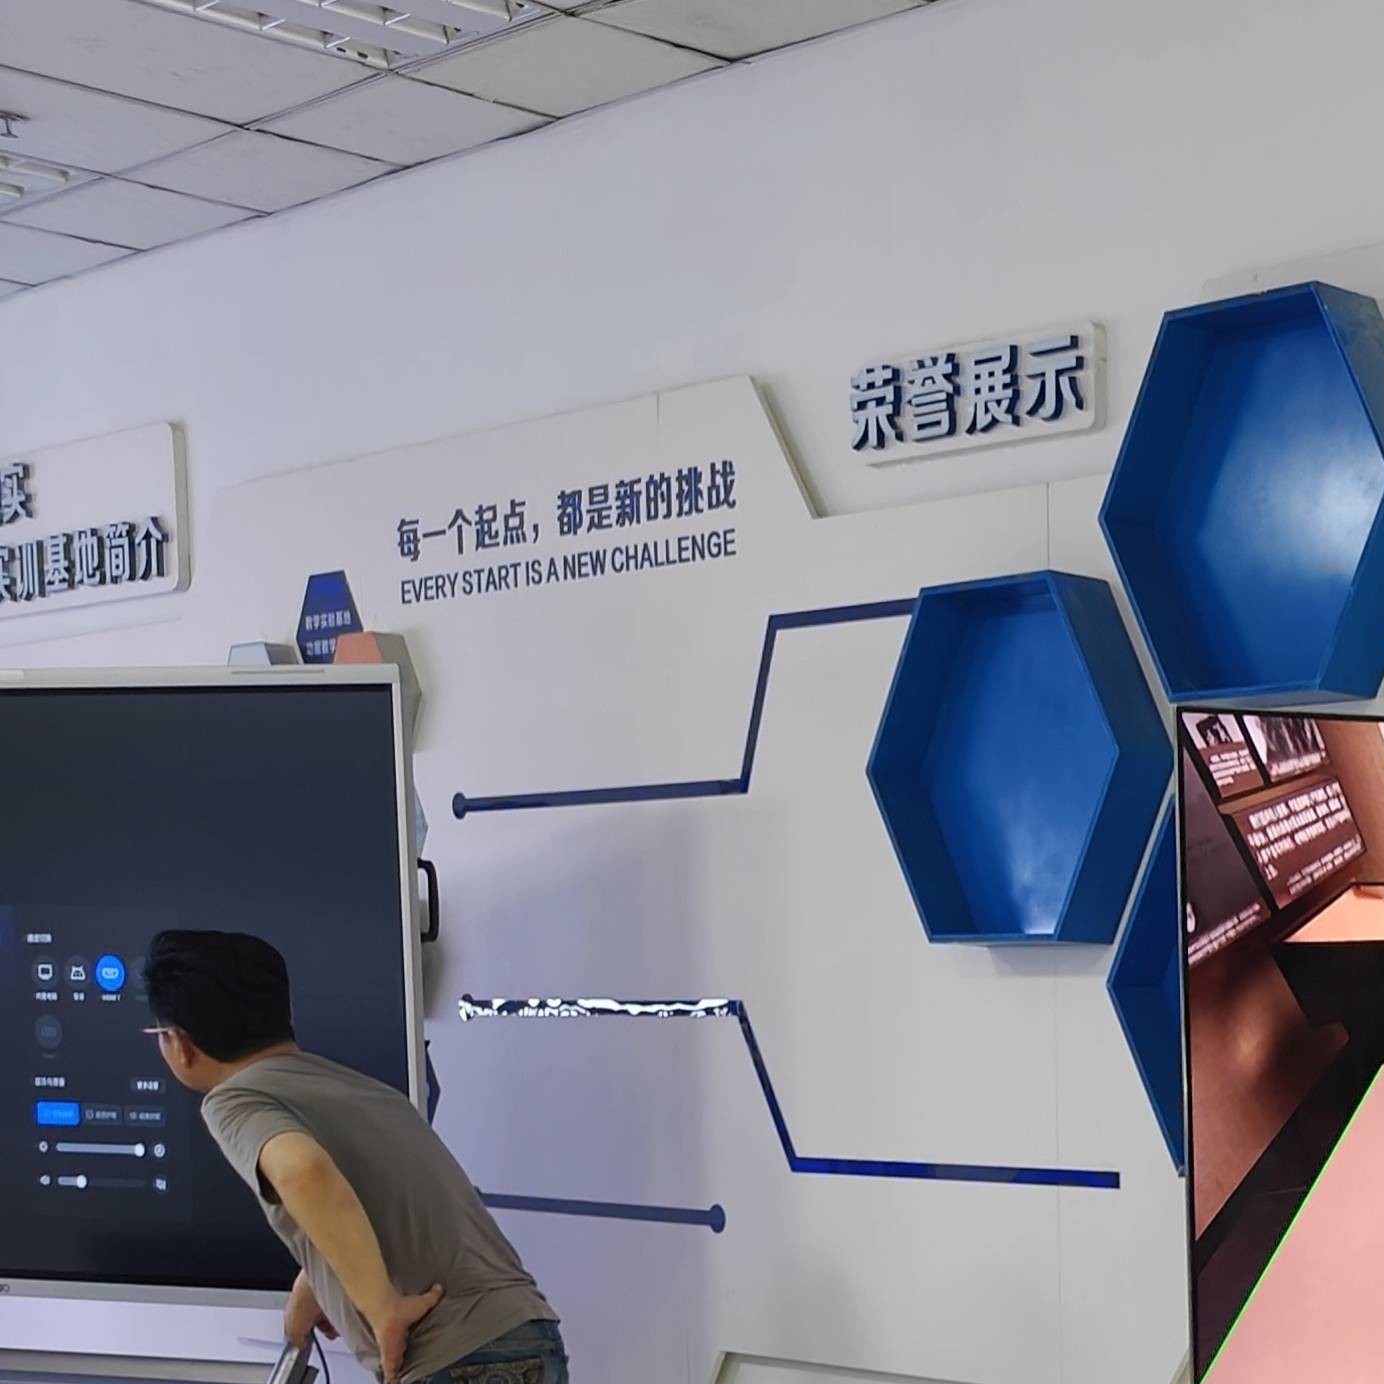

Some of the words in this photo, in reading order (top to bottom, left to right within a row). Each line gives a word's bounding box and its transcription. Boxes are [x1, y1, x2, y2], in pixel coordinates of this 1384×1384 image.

[850, 335, 1084, 450] 荣誉展示
[397, 460, 737, 562] 每一个起点，都是新的挑战
[401, 572, 458, 604] EVERY
[462, 562, 522, 595] START
[525, 559, 543, 587] IS
[545, 557, 560, 583] A
[562, 549, 607, 581] NEW
[611, 528, 737, 574] CHALLENGE
